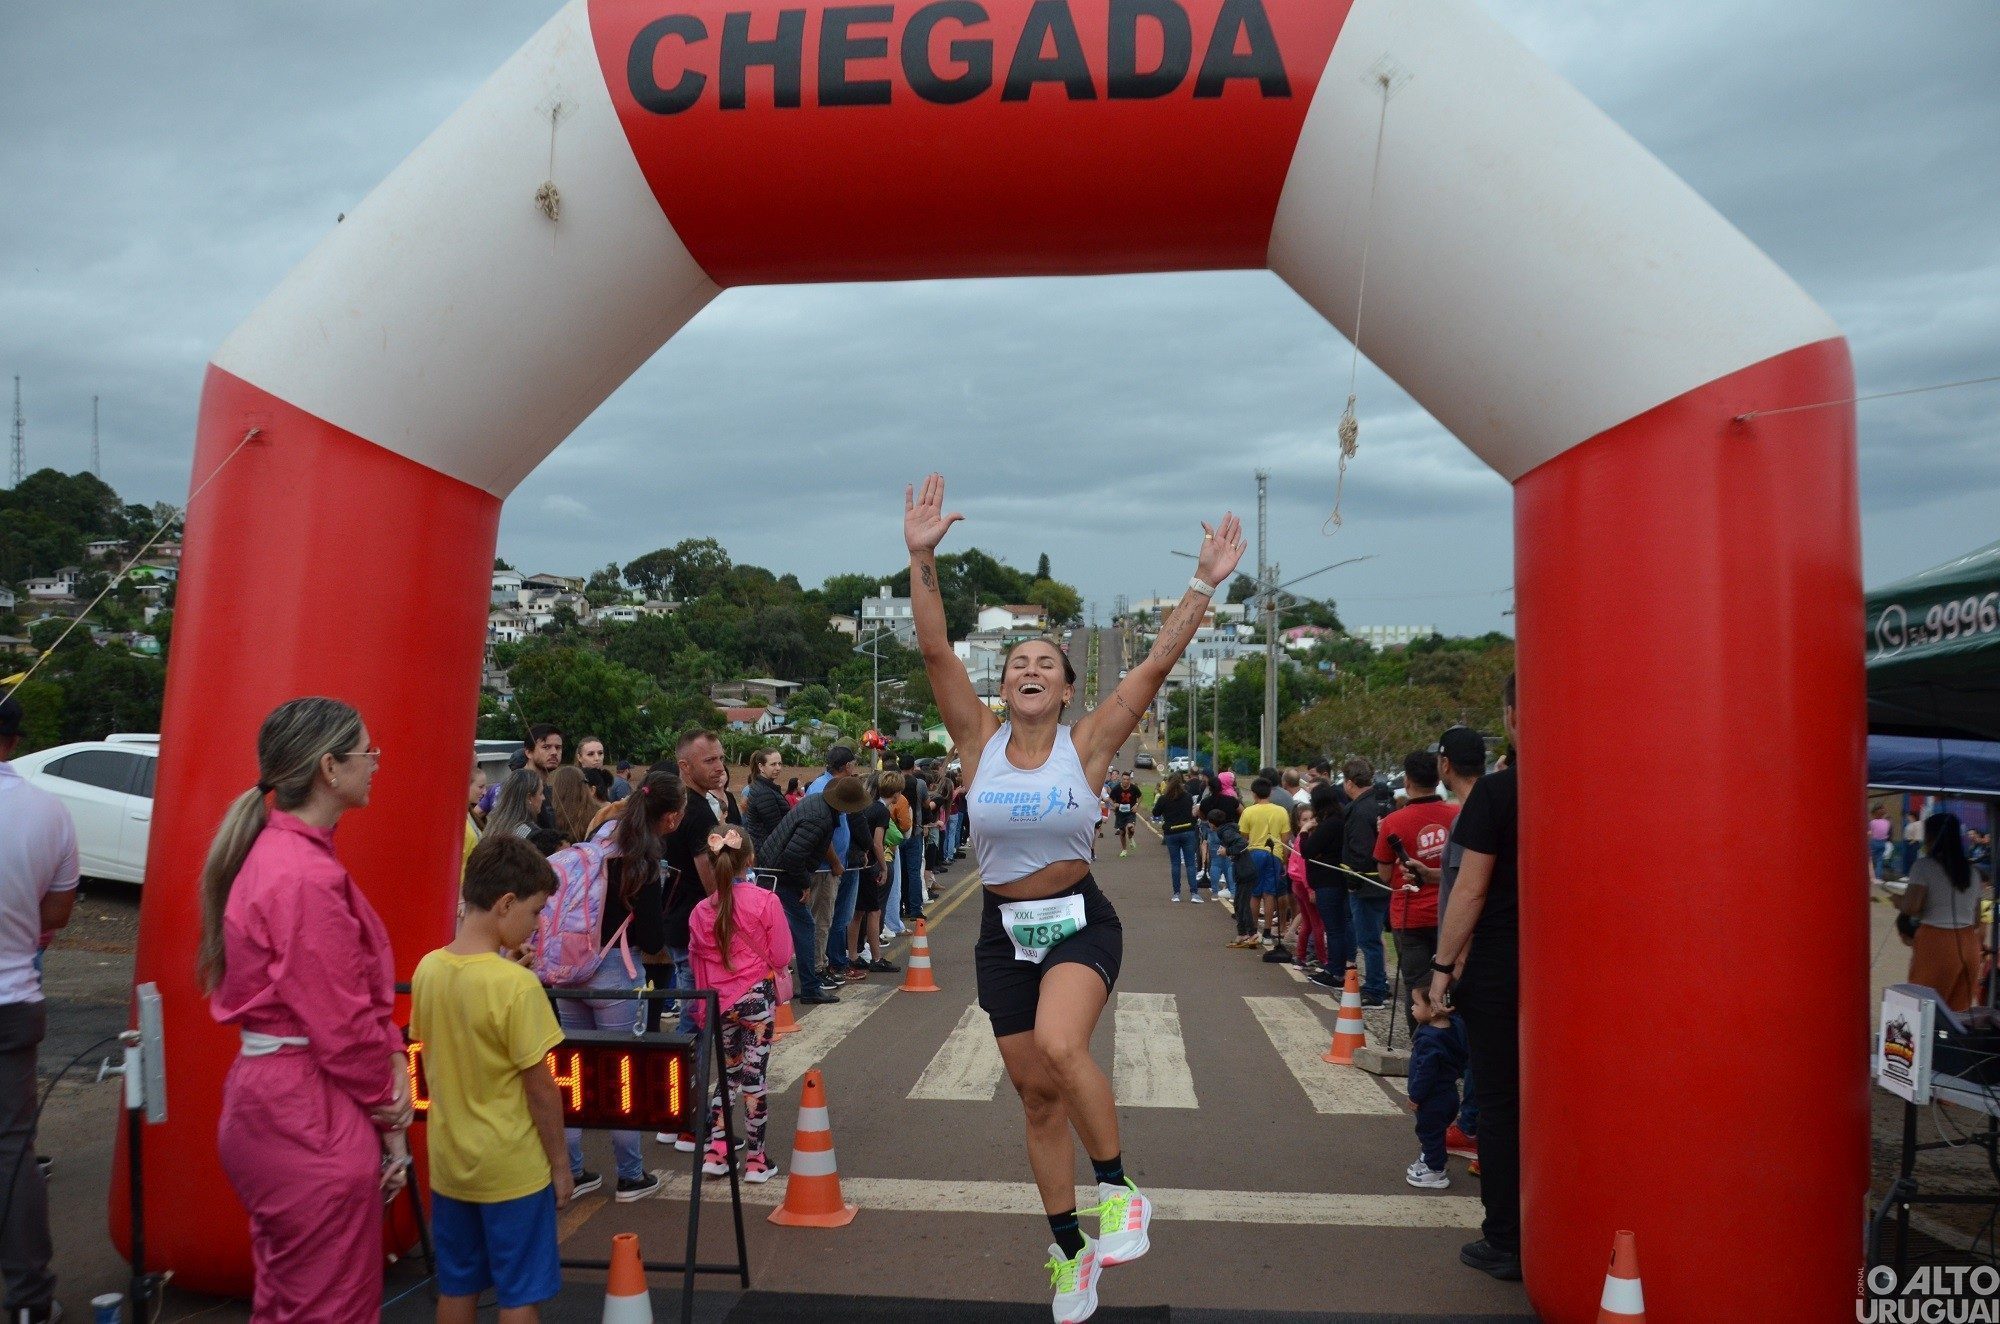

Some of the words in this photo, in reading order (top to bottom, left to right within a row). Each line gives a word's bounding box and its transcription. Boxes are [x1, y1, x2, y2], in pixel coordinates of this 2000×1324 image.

[626, 0, 1293, 115] CHEGADA
[977, 791, 1041, 804] CORRIDA
[1420, 828, 1446, 848] 87.9
[1023, 923, 1065, 946] 788
